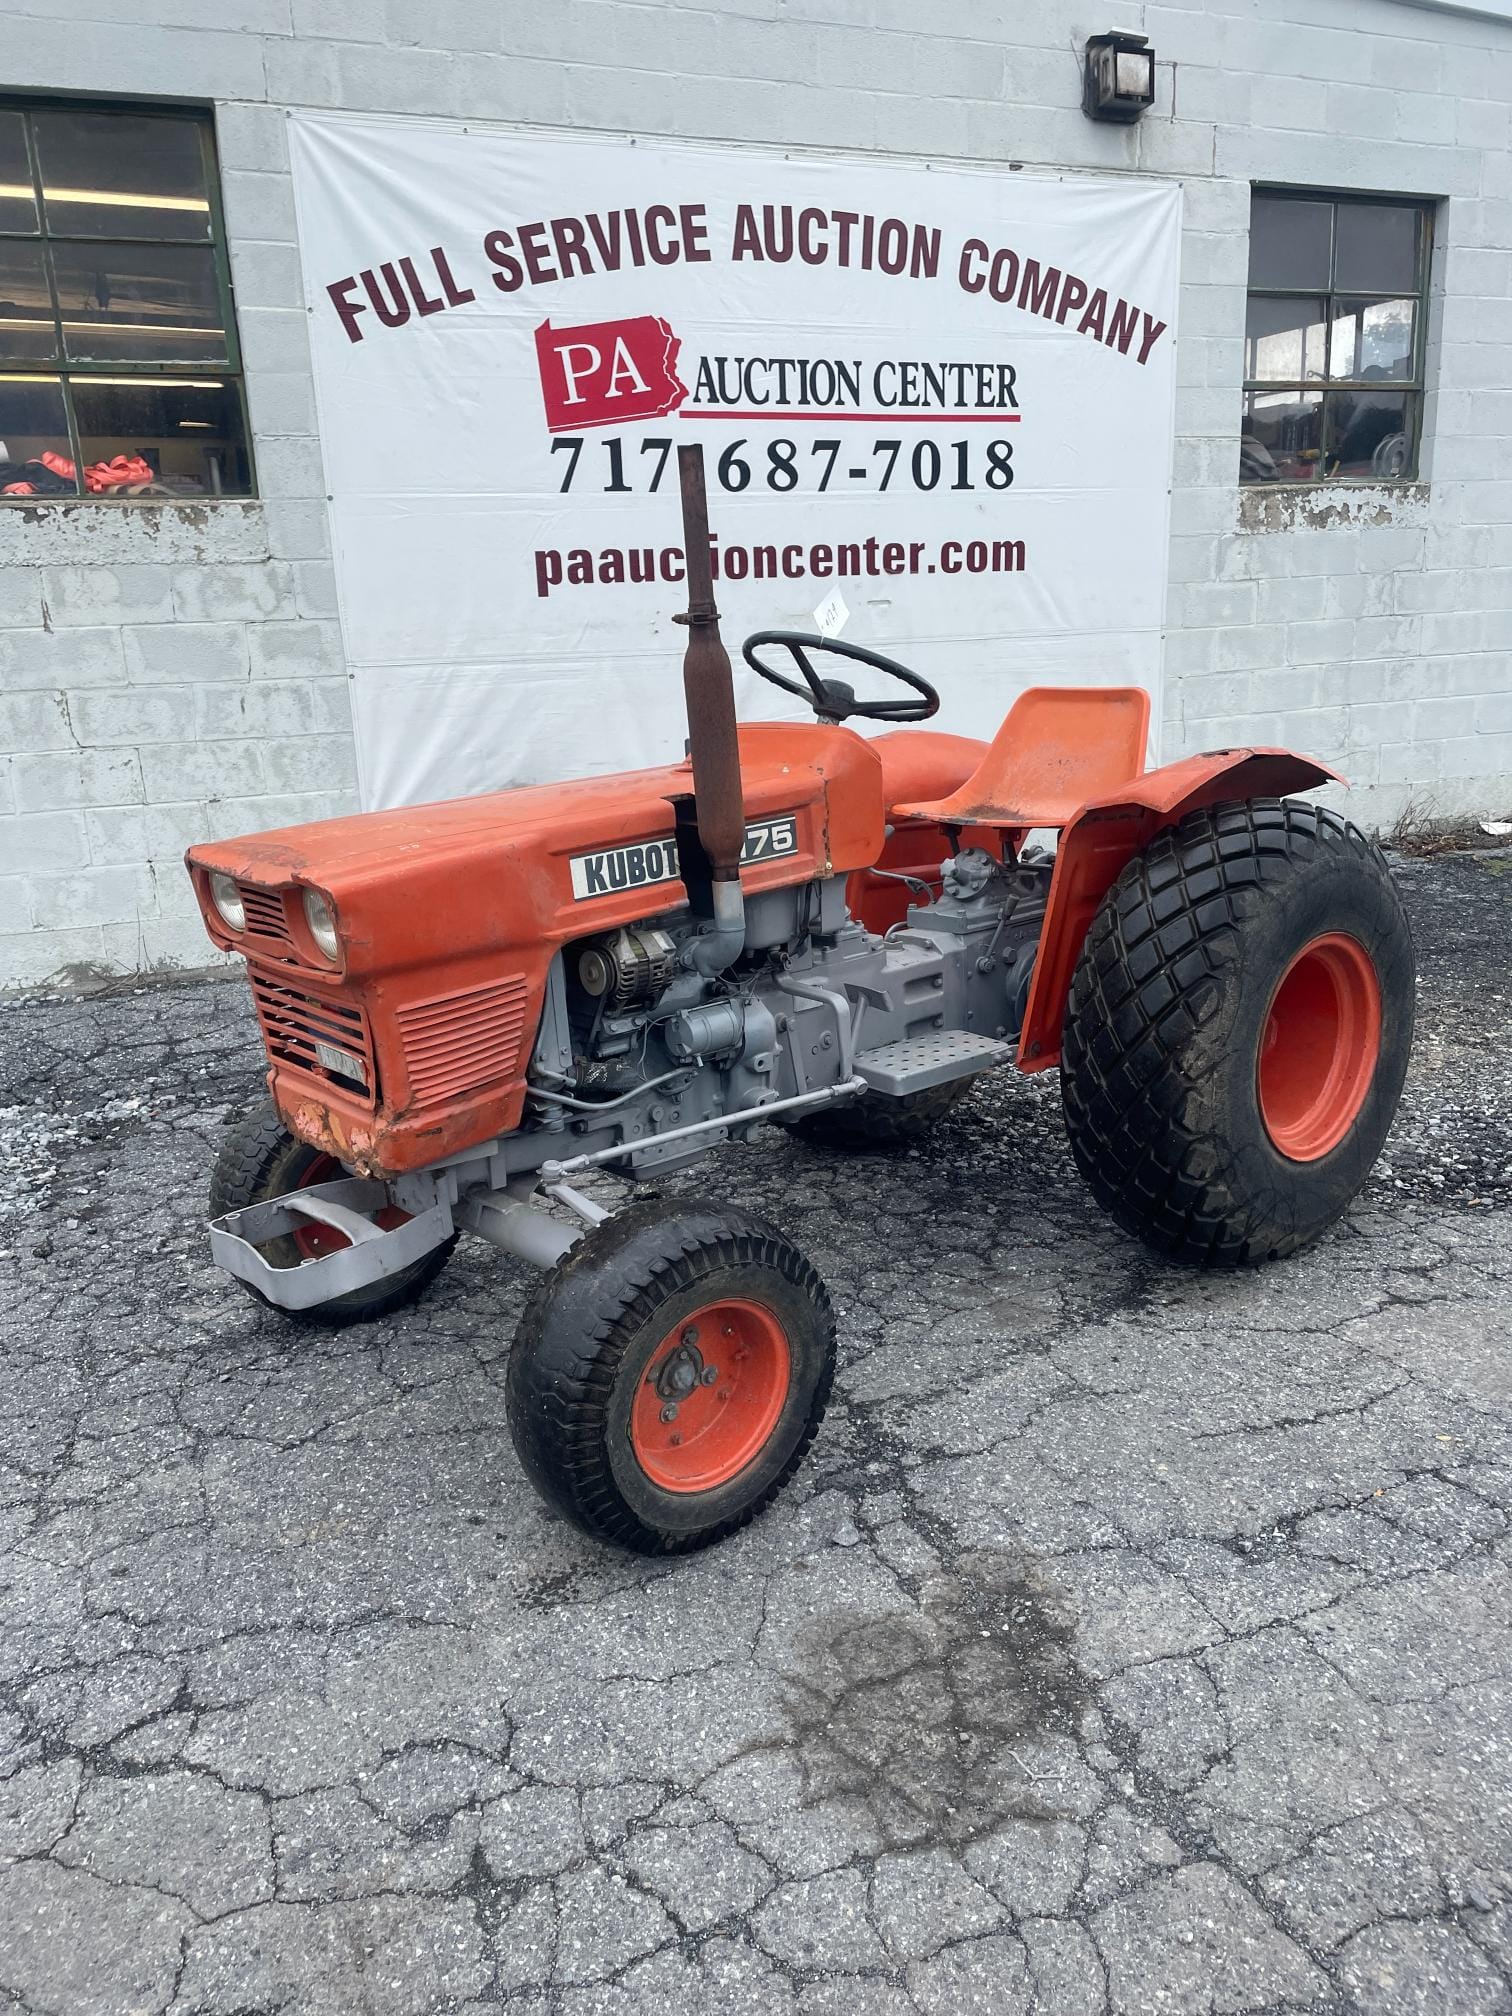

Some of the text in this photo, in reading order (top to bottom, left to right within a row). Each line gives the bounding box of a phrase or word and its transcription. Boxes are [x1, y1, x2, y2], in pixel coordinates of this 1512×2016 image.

[326, 204, 1167, 366] FULL SERVICE AUCTION COMPANY
[553, 337, 1019, 408] PA AUCTION CENTER
[534, 533, 1026, 597] paaucioncenter.com
[584, 823, 793, 894] KUBOT 75
